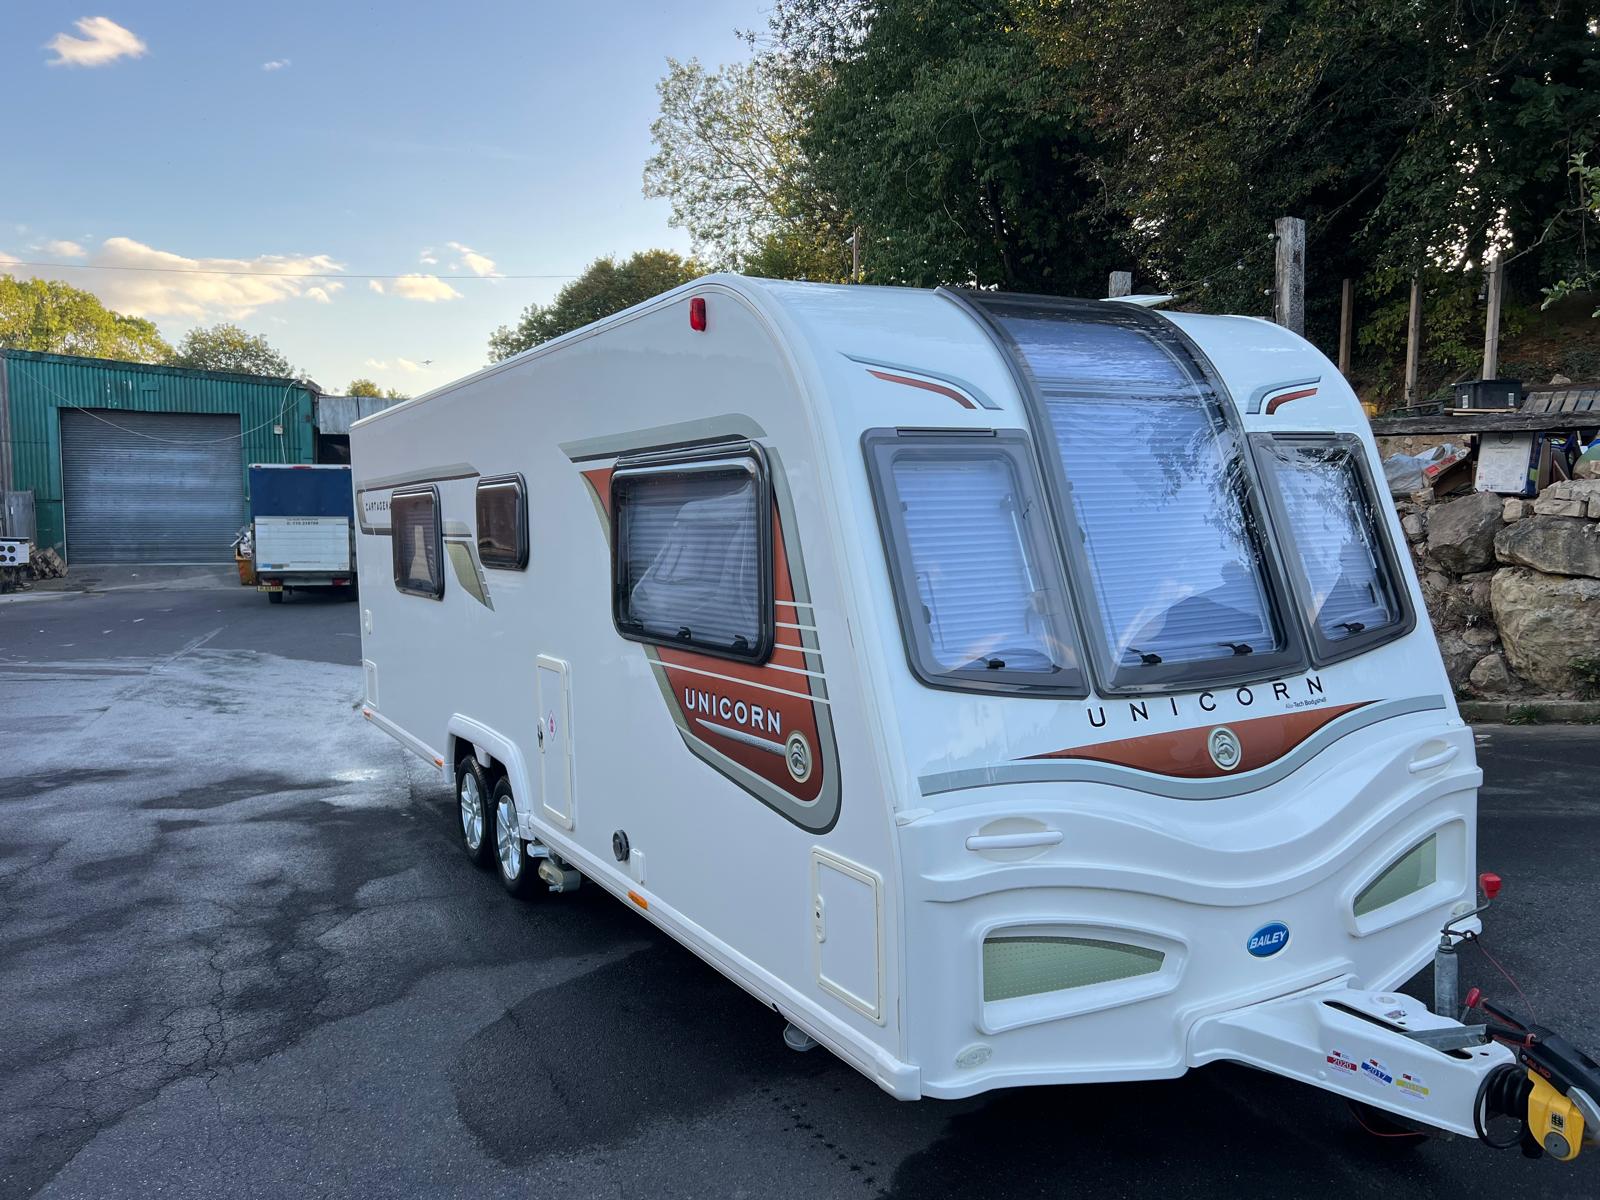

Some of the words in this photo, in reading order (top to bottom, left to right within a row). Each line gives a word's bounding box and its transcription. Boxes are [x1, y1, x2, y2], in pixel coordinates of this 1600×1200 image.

[685, 687, 781, 735] UNICORN
[1087, 676, 1324, 728] UNICORN
[1250, 930, 1287, 949] BAILEY
[1333, 1057, 1352, 1069] 2020
[1367, 1064, 1386, 1078] 2017
